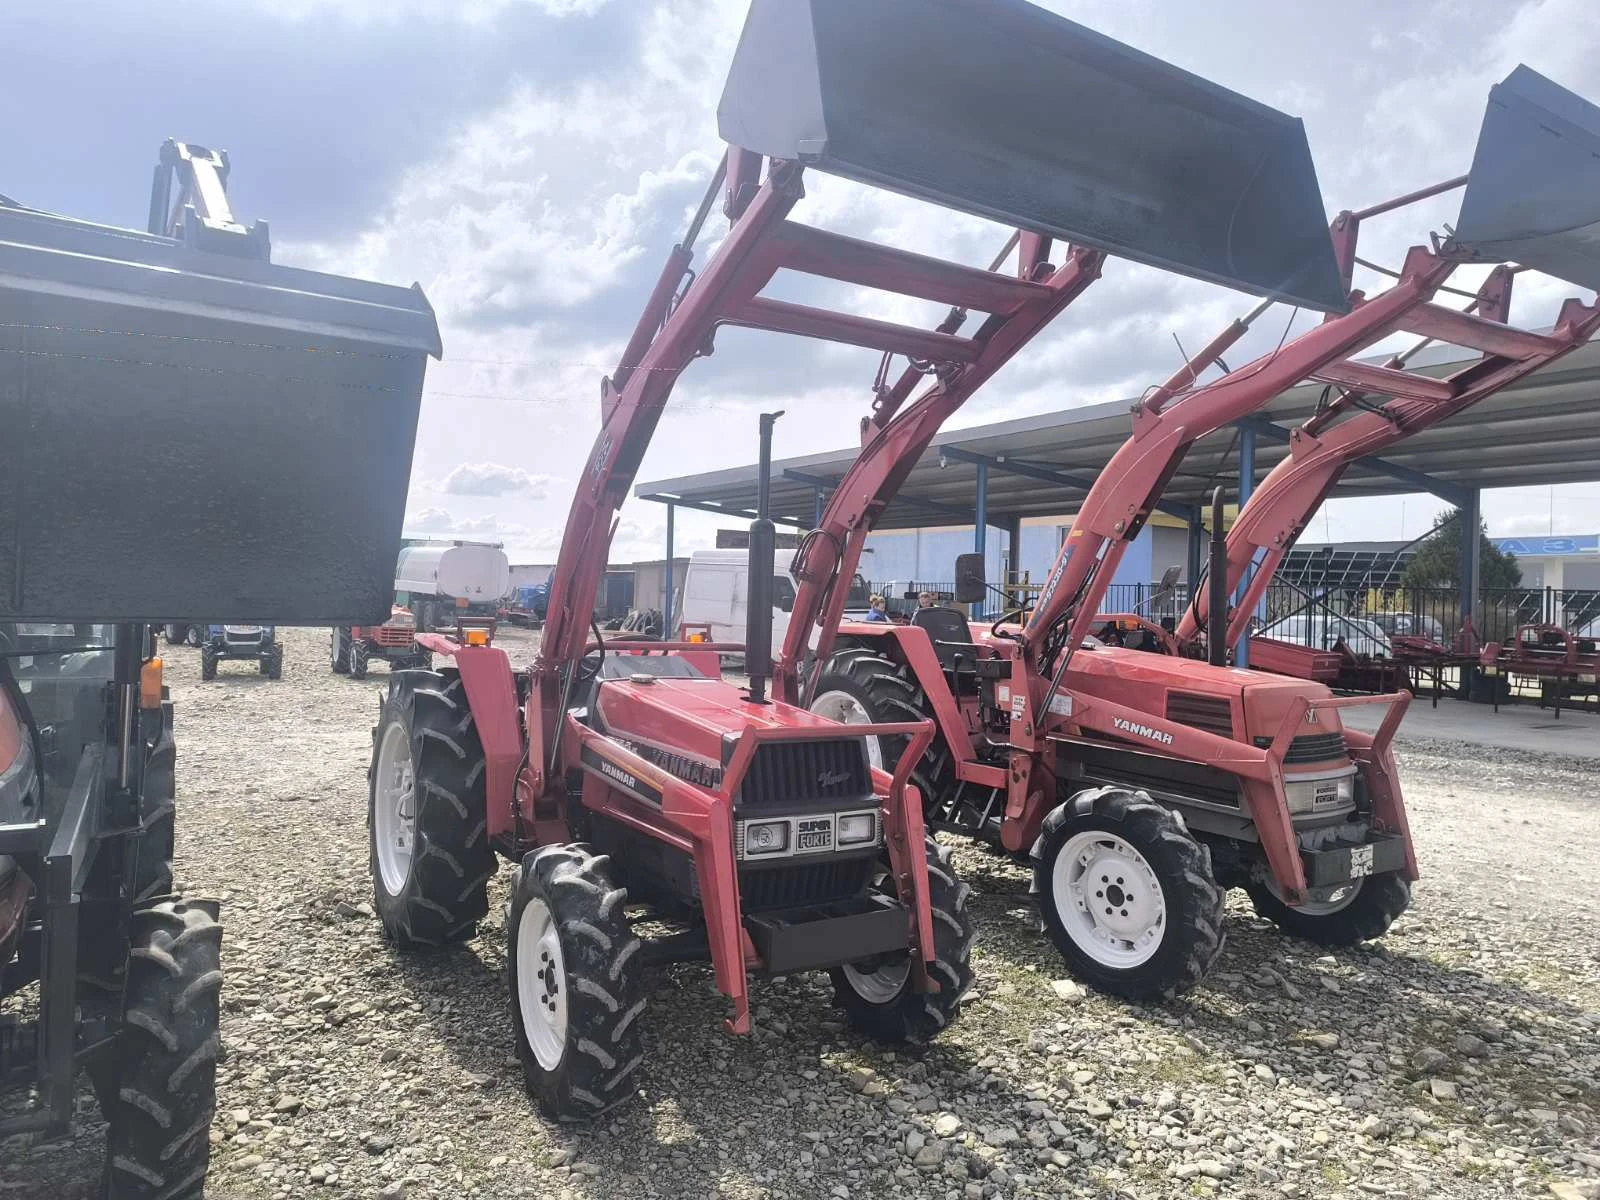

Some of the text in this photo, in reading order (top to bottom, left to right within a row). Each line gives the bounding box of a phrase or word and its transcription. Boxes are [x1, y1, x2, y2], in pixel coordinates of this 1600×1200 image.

[1112, 716, 1173, 744] YANMAR
[600, 761, 636, 787] YANMAR
[799, 820, 830, 832] SUPER
[799, 831, 831, 848] FORTE
